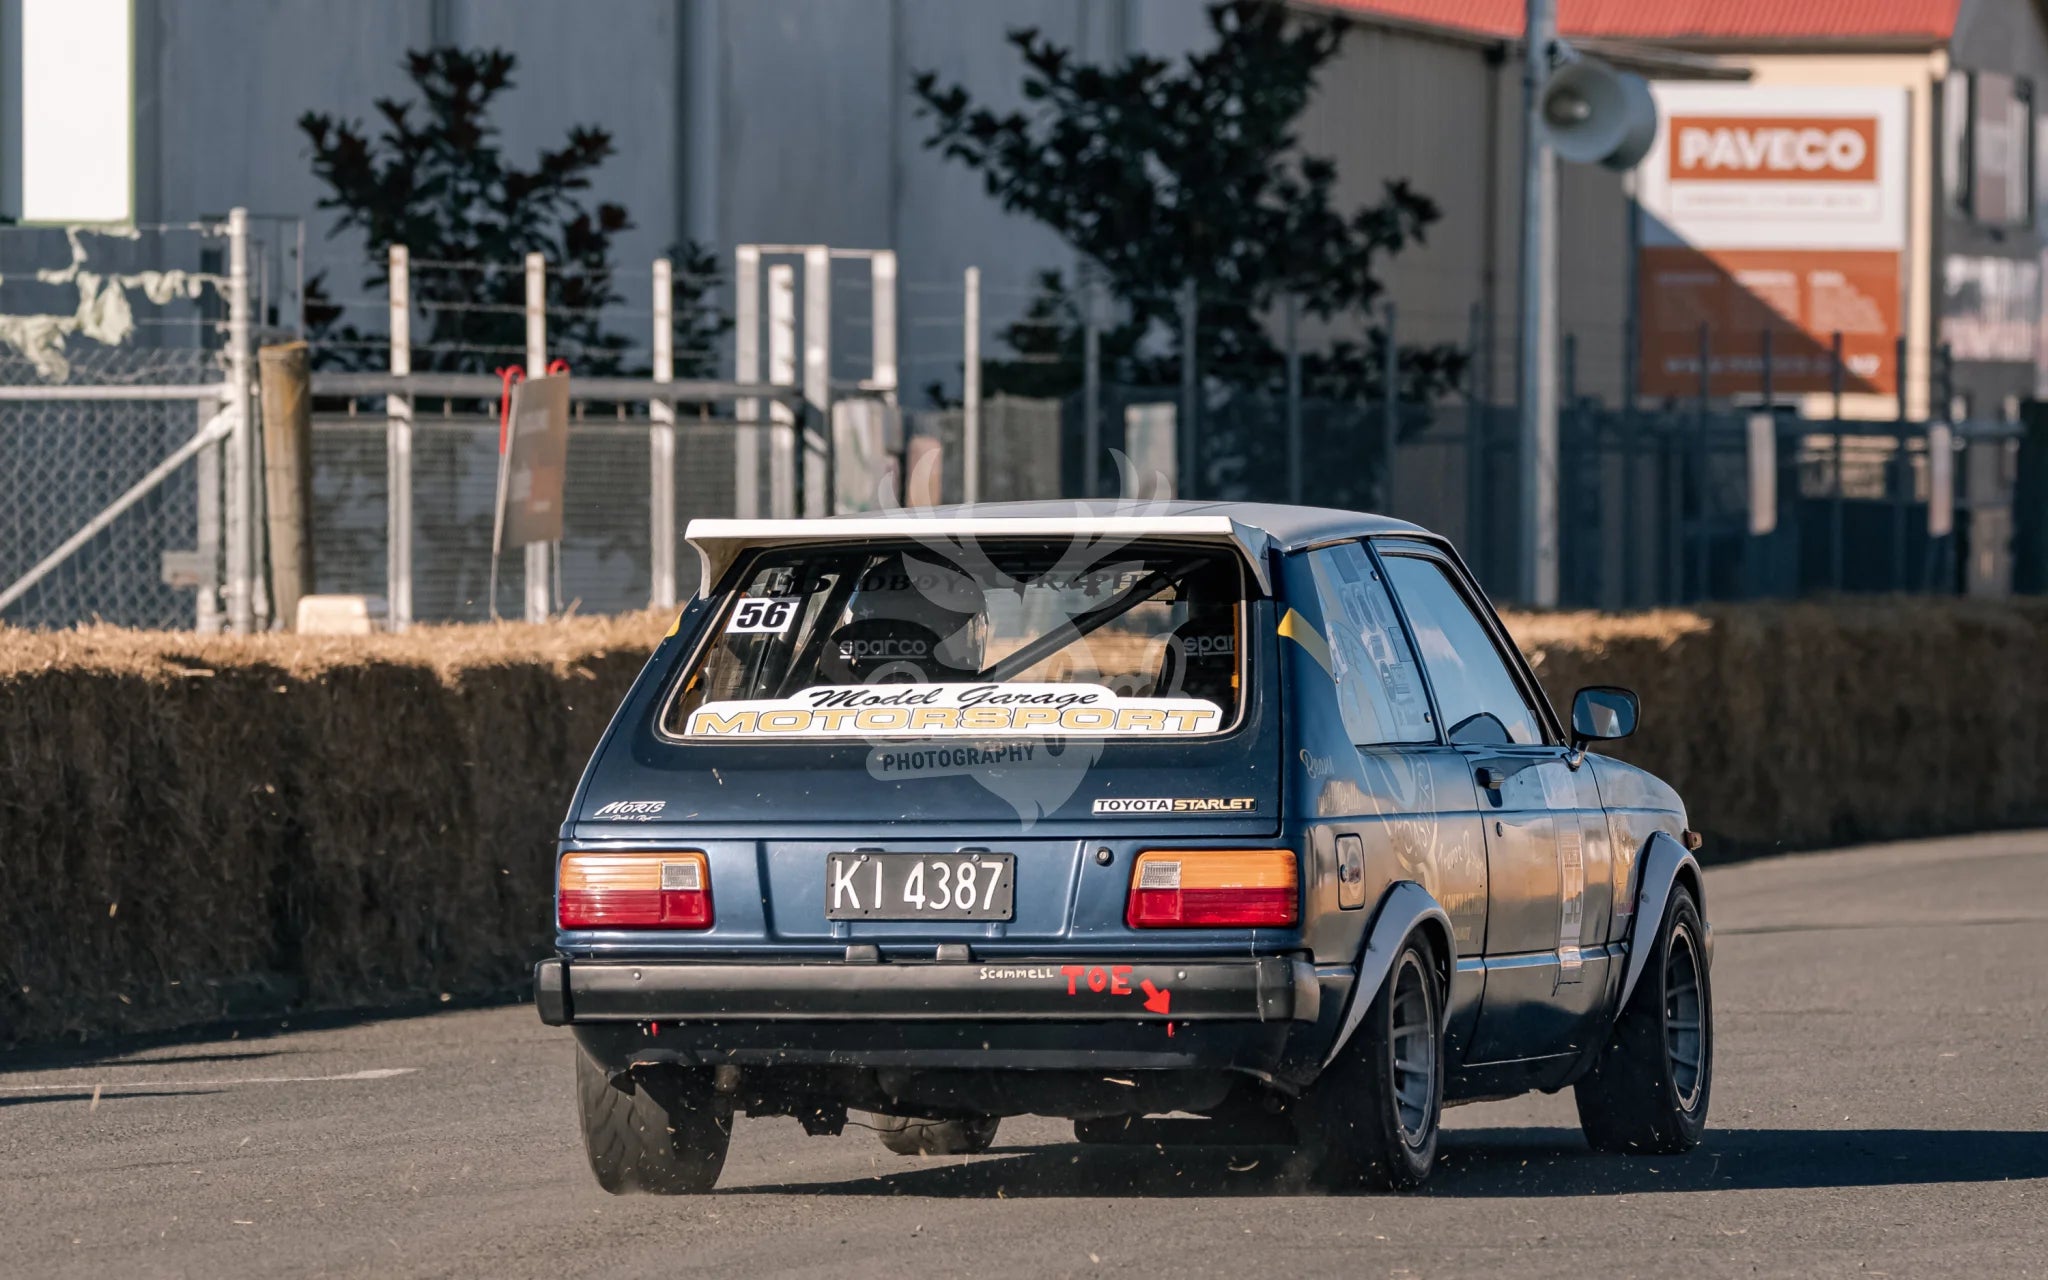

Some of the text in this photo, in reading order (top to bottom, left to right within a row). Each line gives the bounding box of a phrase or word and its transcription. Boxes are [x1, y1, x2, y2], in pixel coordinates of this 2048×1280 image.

[1678, 127, 1866, 170] PAVECO
[736, 601, 791, 629] 56
[839, 637, 928, 659] sparco
[1183, 634, 1236, 657] spar
[809, 684, 1099, 710] Model Garage
[691, 706, 1215, 736] MOTORSPORT
[1097, 798, 1255, 811] TOYOTA STARLET
[833, 860, 1004, 910] KI 4387
[1060, 965, 1133, 996] TOE
